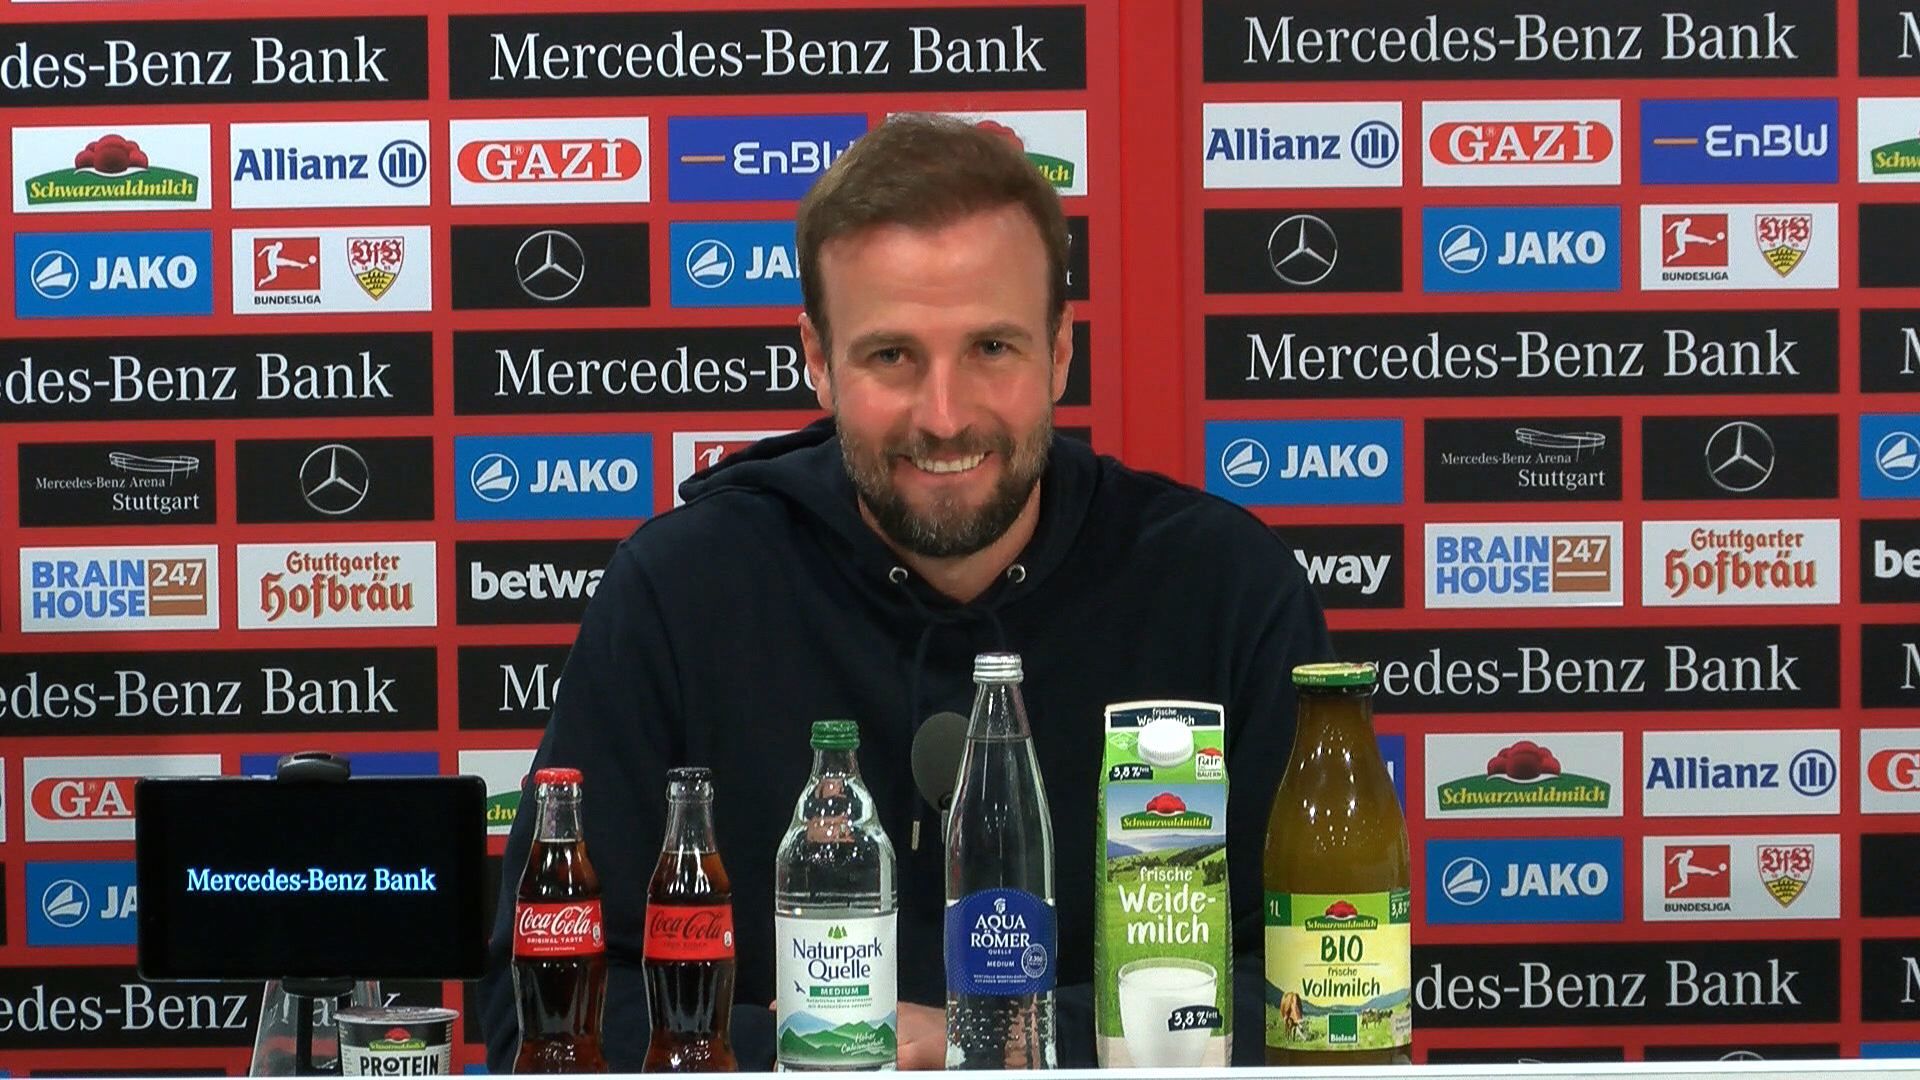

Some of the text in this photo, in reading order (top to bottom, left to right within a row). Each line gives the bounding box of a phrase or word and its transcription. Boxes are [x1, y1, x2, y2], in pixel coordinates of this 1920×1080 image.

[490, 25, 1047, 80] Mercedes-Benz Bank
[1243, 12, 1799, 64] Mercedes-Benz Bank
[251, 35, 389, 85] Bank
[1206, 127, 1340, 161] Allianz
[1706, 124, 1828, 157] EnBW
[234, 147, 368, 182] Allianz
[29, 178, 195, 201] Schwarzwaldmilch
[746, 246, 800, 279] JA
[1498, 231, 1606, 266] JAKO
[90, 255, 198, 291] JAKO
[1661, 271, 1729, 282] BUNDESLIGA
[253, 295, 322, 306] BUNDESLIGA
[1246, 328, 1801, 381] Mercedes-Benz Bank
[0, 351, 394, 405] des-Benz Bank
[1281, 443, 1389, 479] JAKO
[1441, 452, 1572, 465] Mercedes-Benz Arena
[36, 476, 166, 489] Mercedes-Benz Arena
[530, 458, 639, 493] JAKO
[1518, 468, 1605, 490] Stuttgart
[112, 492, 200, 515] Stuttgart
[1437, 535, 1607, 564] BRAIN 247
[1690, 527, 1805, 553] Stuttgarter
[32, 560, 203, 588] BRAIN 247
[286, 550, 400, 578] Stuttgarter
[1664, 551, 1817, 599] Hofbräu
[1437, 566, 1549, 595] HOUSE
[33, 589, 145, 620] HOUSE
[260, 572, 415, 622] Hofbräu
[1664, 644, 1801, 692] Bank
[261, 666, 398, 715] Bank
[1646, 756, 1779, 790] Allianz
[1441, 786, 1606, 807] Schwarzwaldmilch
[1122, 817, 1210, 828] Schwarzwaldmilch
[187, 868, 437, 892] Mercedes-Benz Bank
[1139, 866, 1193, 882] frische
[1501, 862, 1609, 897] JAKO
[1118, 883, 1217, 914] Weide-
[1664, 902, 1732, 913] BUNDESLIGA
[519, 906, 593, 936] Coca-Cola
[651, 910, 723, 940] Coca-Cola
[975, 914, 1027, 933] AQUA
[1127, 914, 1210, 945] milch
[793, 937, 883, 963] Naturpark
[970, 930, 1030, 948] RÖMER
[1321, 935, 1363, 962] BIO
[808, 959, 871, 983] Quelle
[986, 960, 1015, 968] MEDIUM
[1327, 966, 1358, 977] frische
[820, 986, 860, 996] MEDIUM
[1302, 977, 1380, 998] Vollmilch
[1666, 958, 1802, 1007] Bank
[1330, 1033, 1357, 1043] Bioland
[360, 1053, 439, 1077] PROTEIN
